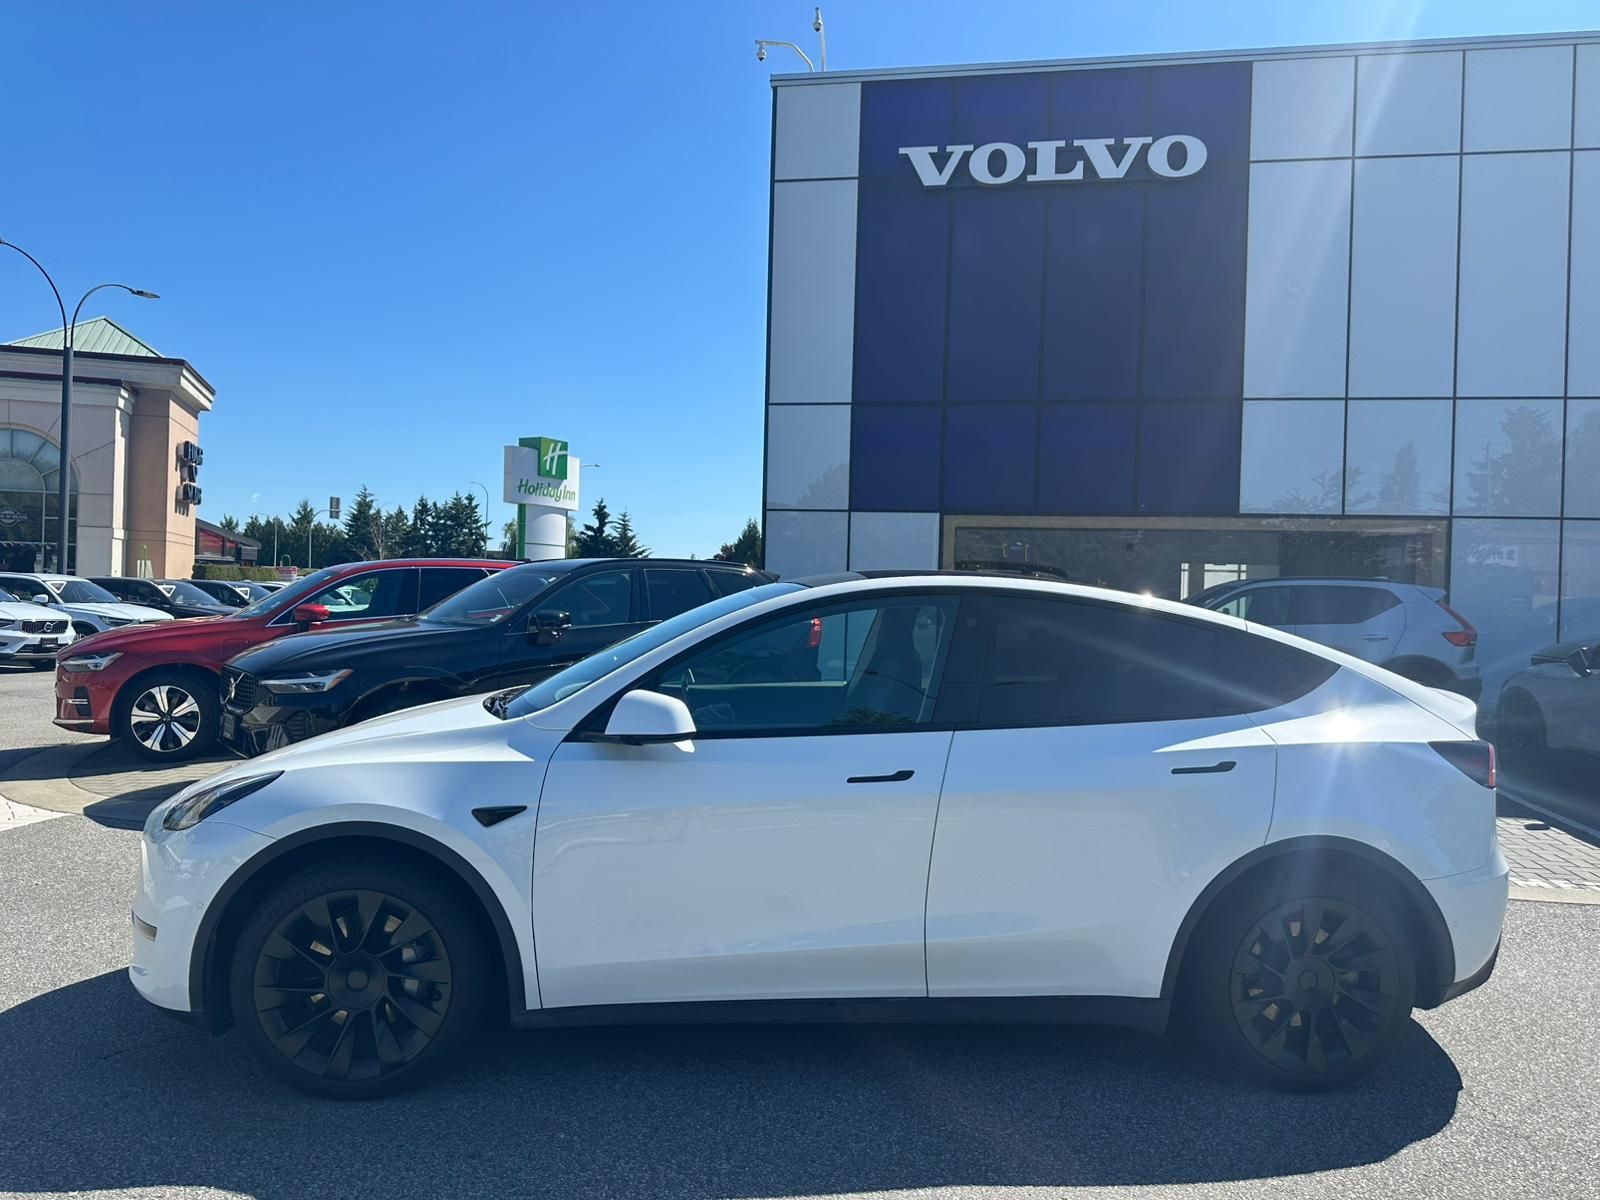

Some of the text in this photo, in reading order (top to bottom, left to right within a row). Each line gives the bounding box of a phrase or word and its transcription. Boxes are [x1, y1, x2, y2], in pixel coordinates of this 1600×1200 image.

[898, 134, 1208, 187] VOLVO
[517, 478, 576, 502] Holiday Inn
